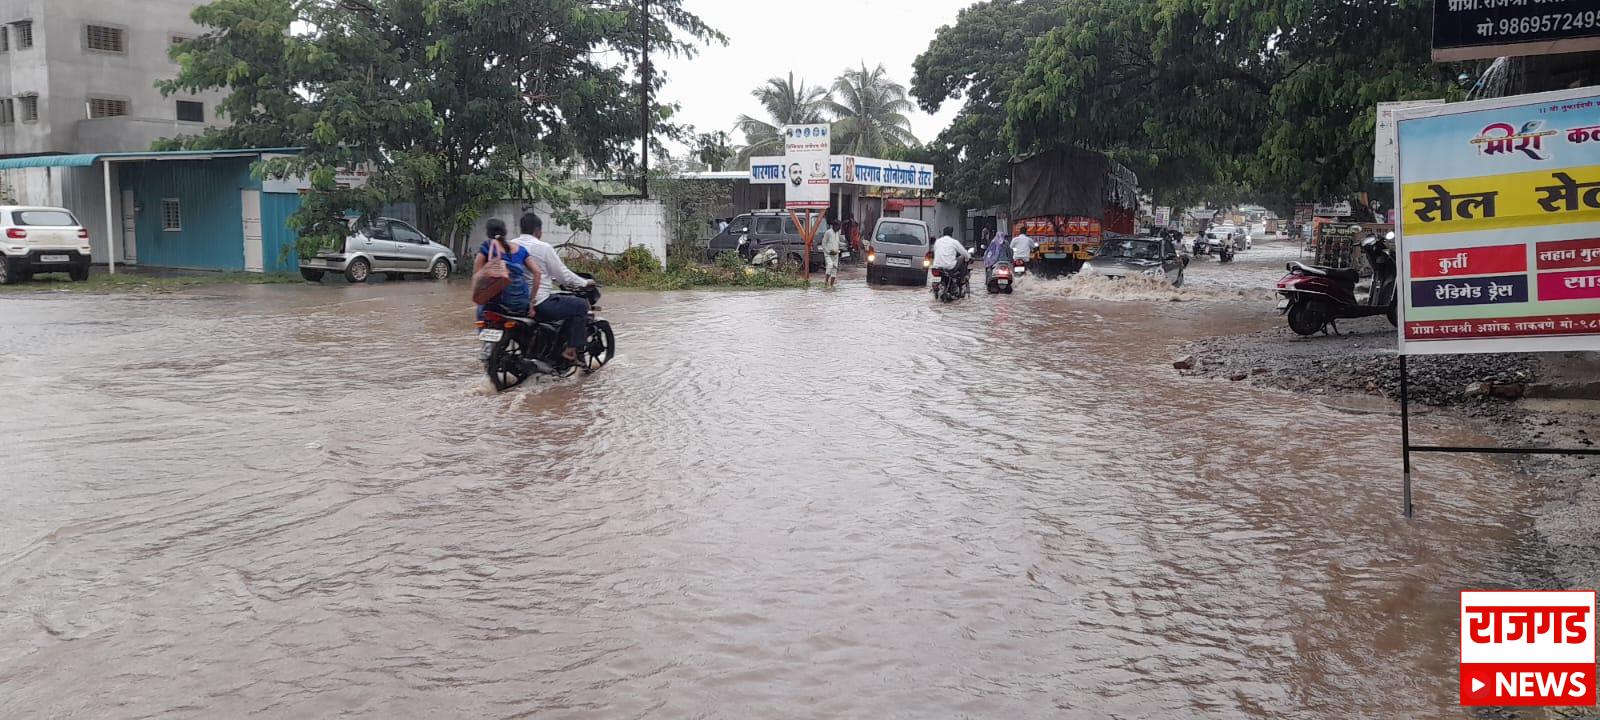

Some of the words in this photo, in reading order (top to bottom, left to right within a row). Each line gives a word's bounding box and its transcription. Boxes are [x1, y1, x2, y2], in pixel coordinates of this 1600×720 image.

[1474, 121, 1555, 160] मीरा
[855, 164, 881, 183] पारगाव
[1413, 184, 1498, 223] सेल
[1439, 252, 1468, 274] कुर्ती
[1539, 249, 1576, 261] लहान
[1435, 282, 1482, 301] रेडिमेड
[1488, 281, 1513, 301] ड्रेस
[1563, 275, 1600, 289] सा
[1477, 320, 1510, 333] अशोक
[1560, 317, 1600, 329] मो-९८
